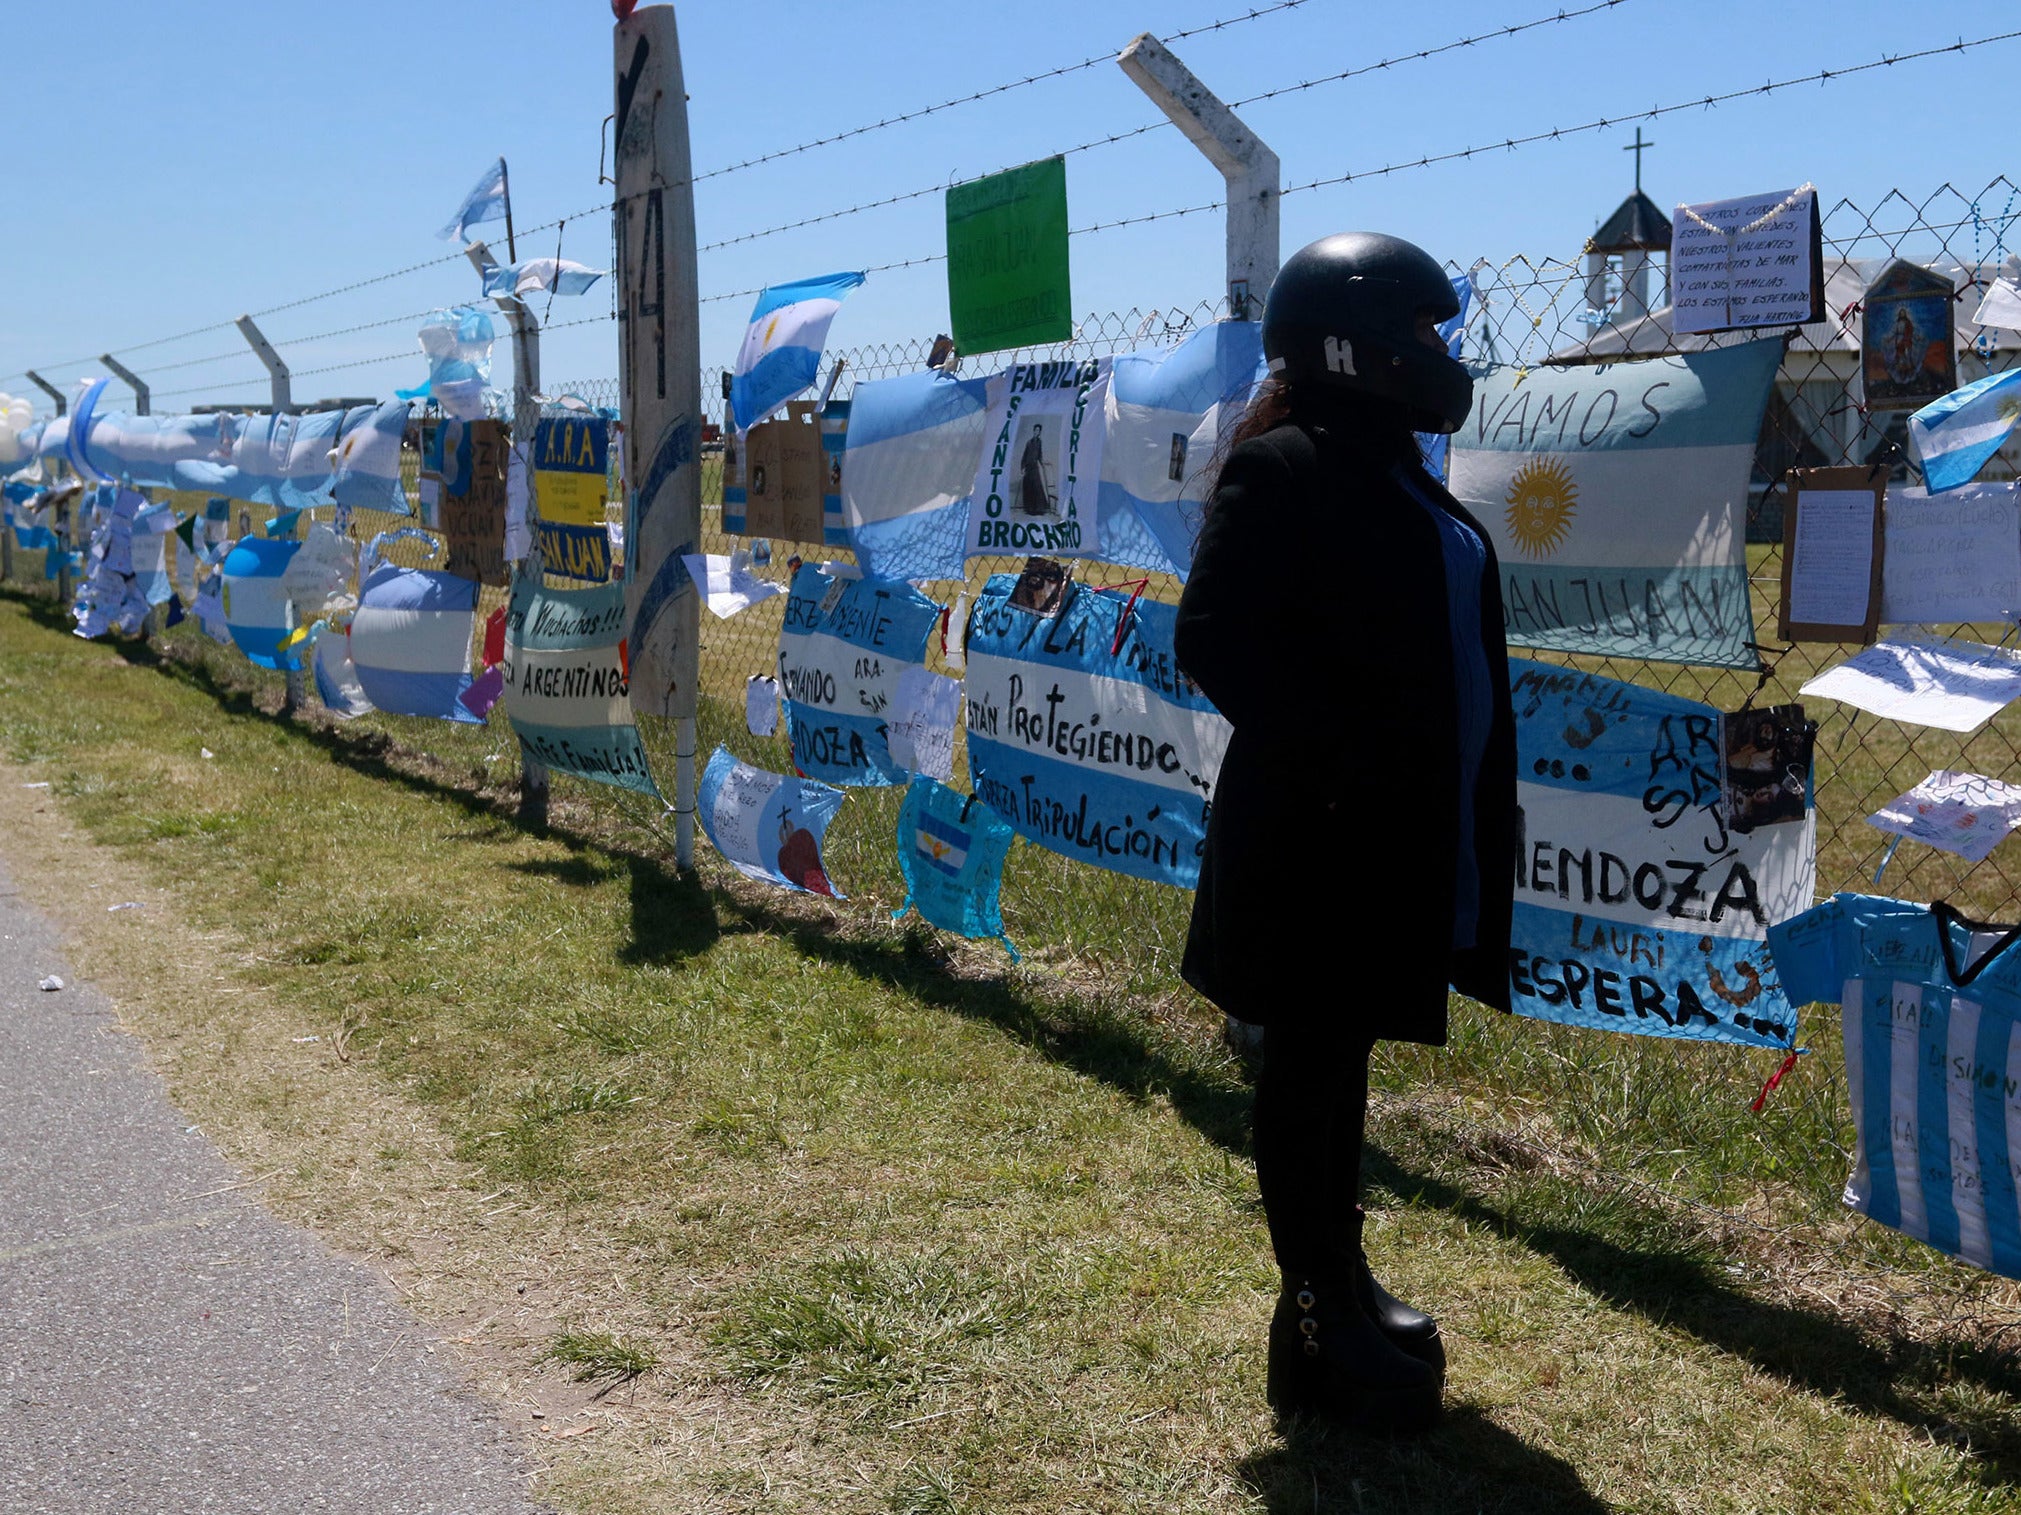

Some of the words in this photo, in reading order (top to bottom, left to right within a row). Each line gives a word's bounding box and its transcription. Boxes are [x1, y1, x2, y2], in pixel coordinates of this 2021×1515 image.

[1678, 245, 1728, 257] NUESTROS
[1737, 240, 1794, 253] VALIENTES
[1755, 255, 1772, 267] DE
[1776, 254, 1799, 267] MAR
[1677, 297, 1697, 308] LOS
[1702, 295, 1746, 307] ESTAMOS
[1752, 291, 1810, 305] ESPERANDO
[1679, 280, 1687, 291] Y
[1688, 280, 1708, 292] CON
[1324, 336, 1357, 376] H
[1010, 359, 1099, 393] FAMILIA
[1478, 382, 1670, 447] VAMOS
[986, 395, 1021, 518] SANTO
[1571, 577, 1727, 642] JUAN
[1516, 805, 1770, 927] ENDOZA
